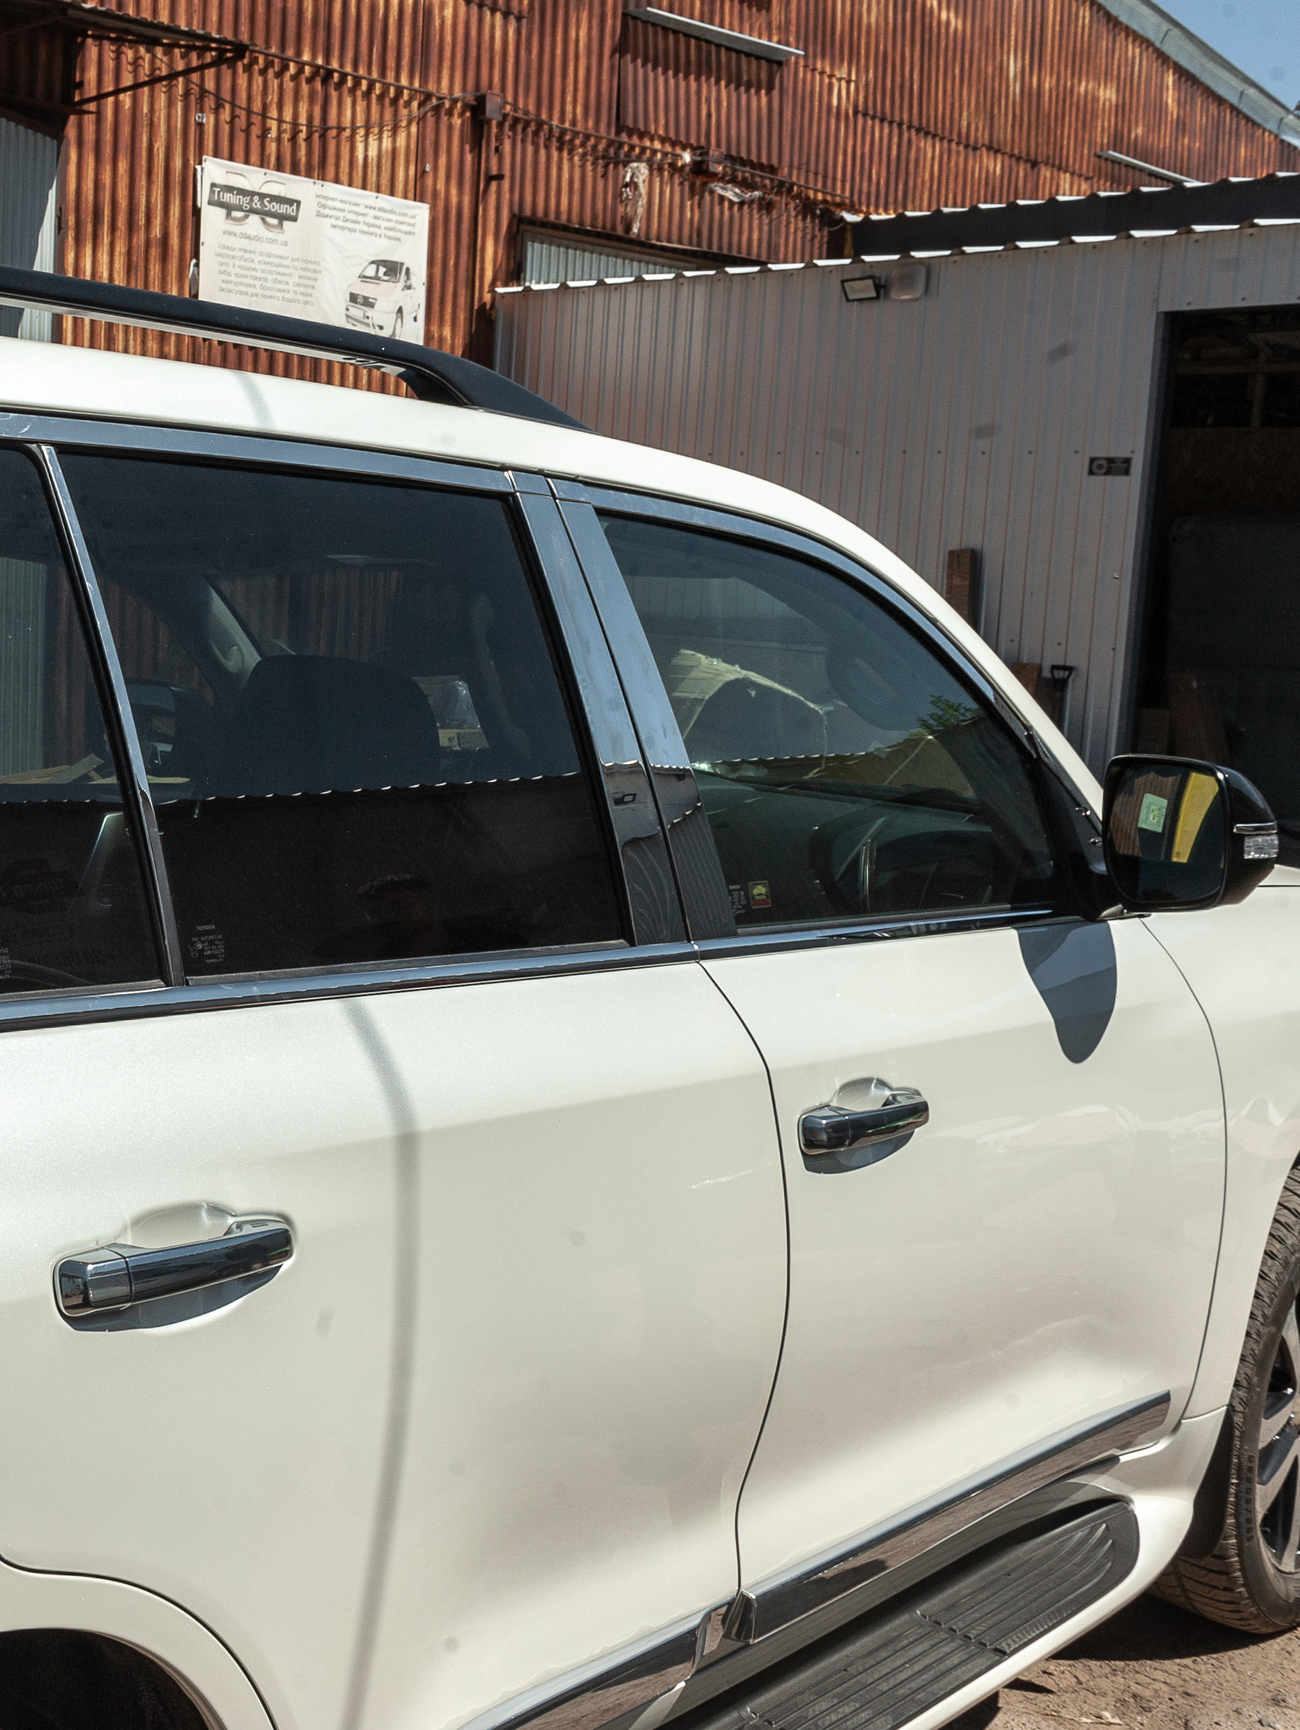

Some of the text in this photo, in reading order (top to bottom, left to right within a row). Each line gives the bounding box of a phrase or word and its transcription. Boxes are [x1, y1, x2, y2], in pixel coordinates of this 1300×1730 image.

[212, 187, 298, 217] Tuning & Sound
